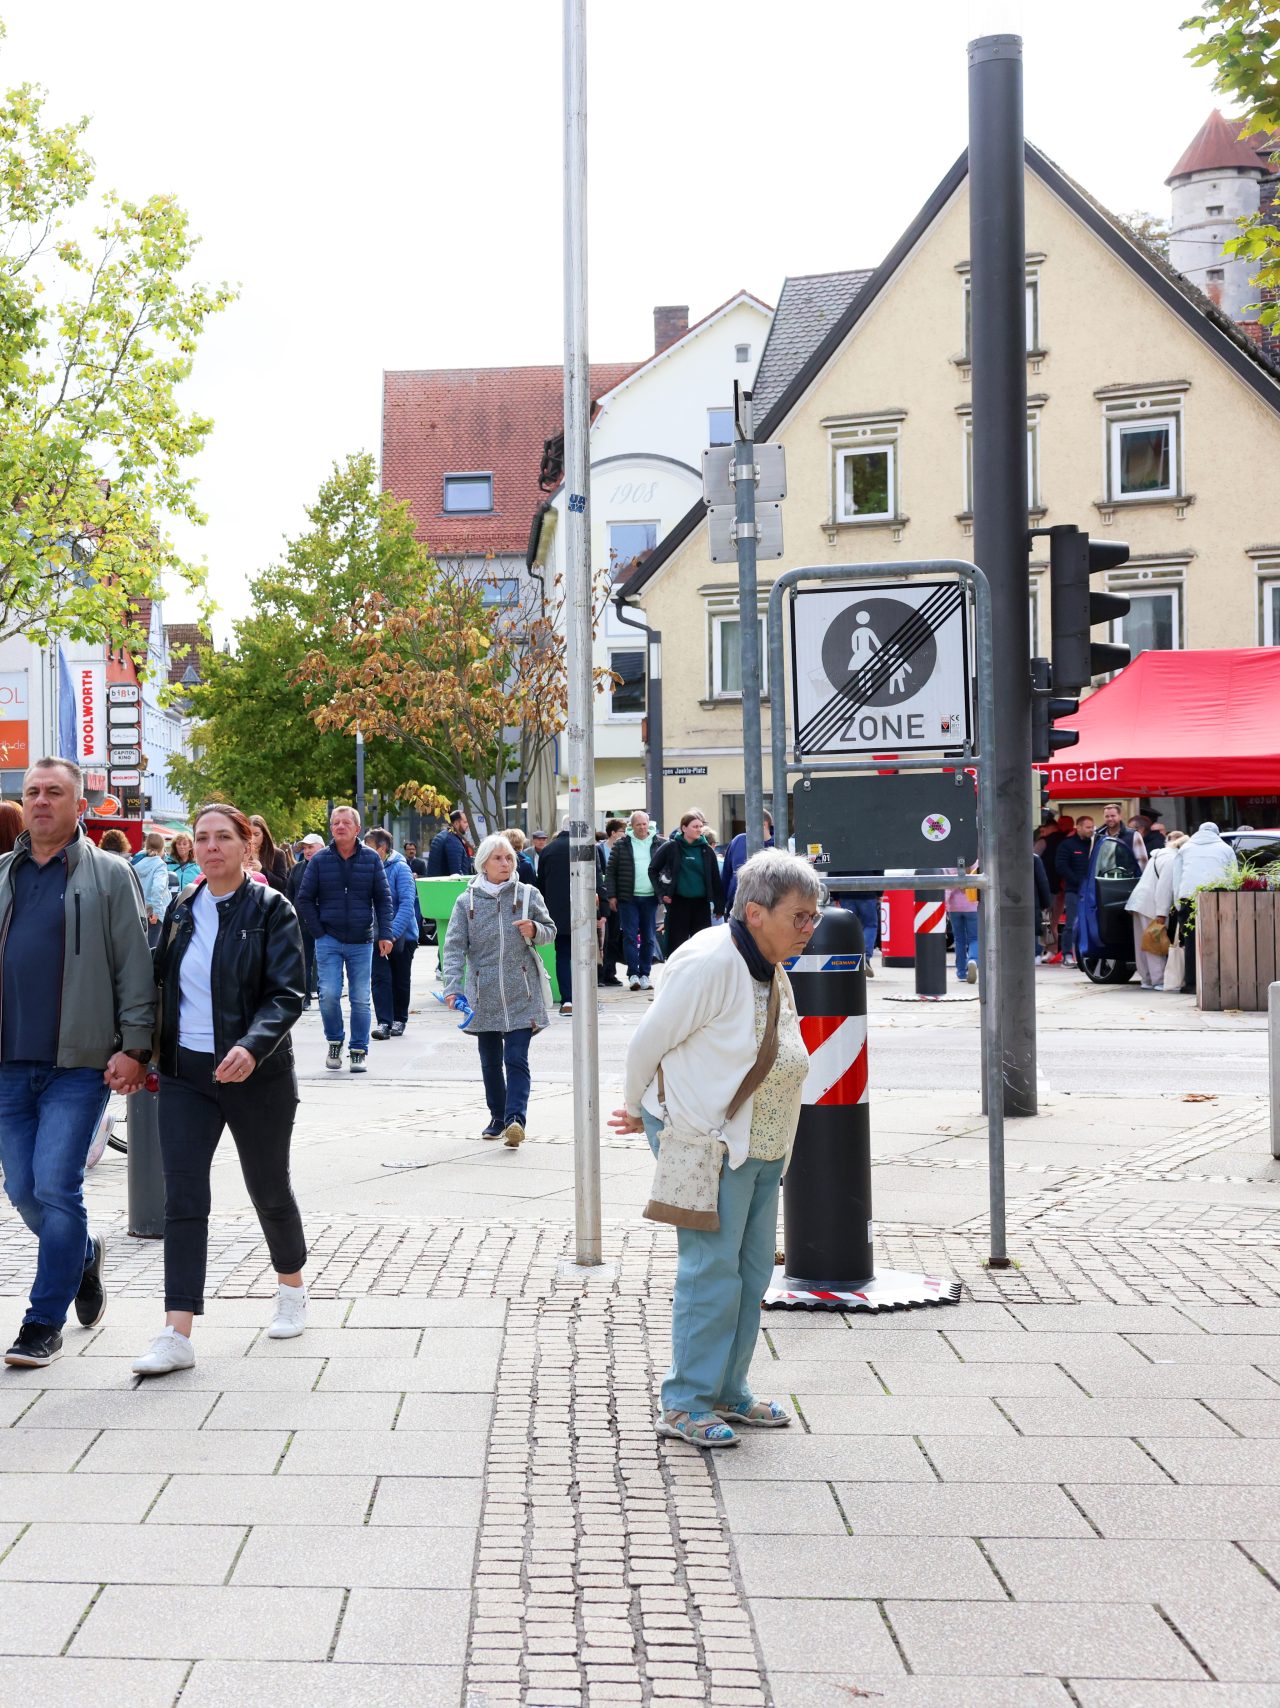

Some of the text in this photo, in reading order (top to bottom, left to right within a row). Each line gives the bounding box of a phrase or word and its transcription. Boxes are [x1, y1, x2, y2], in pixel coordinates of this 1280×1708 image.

[610, 481, 658, 504] 1908
[82, 669, 94, 757] WOOLWORTH
[839, 713, 925, 742] ZONE
[127, 798, 148, 806] yogs
